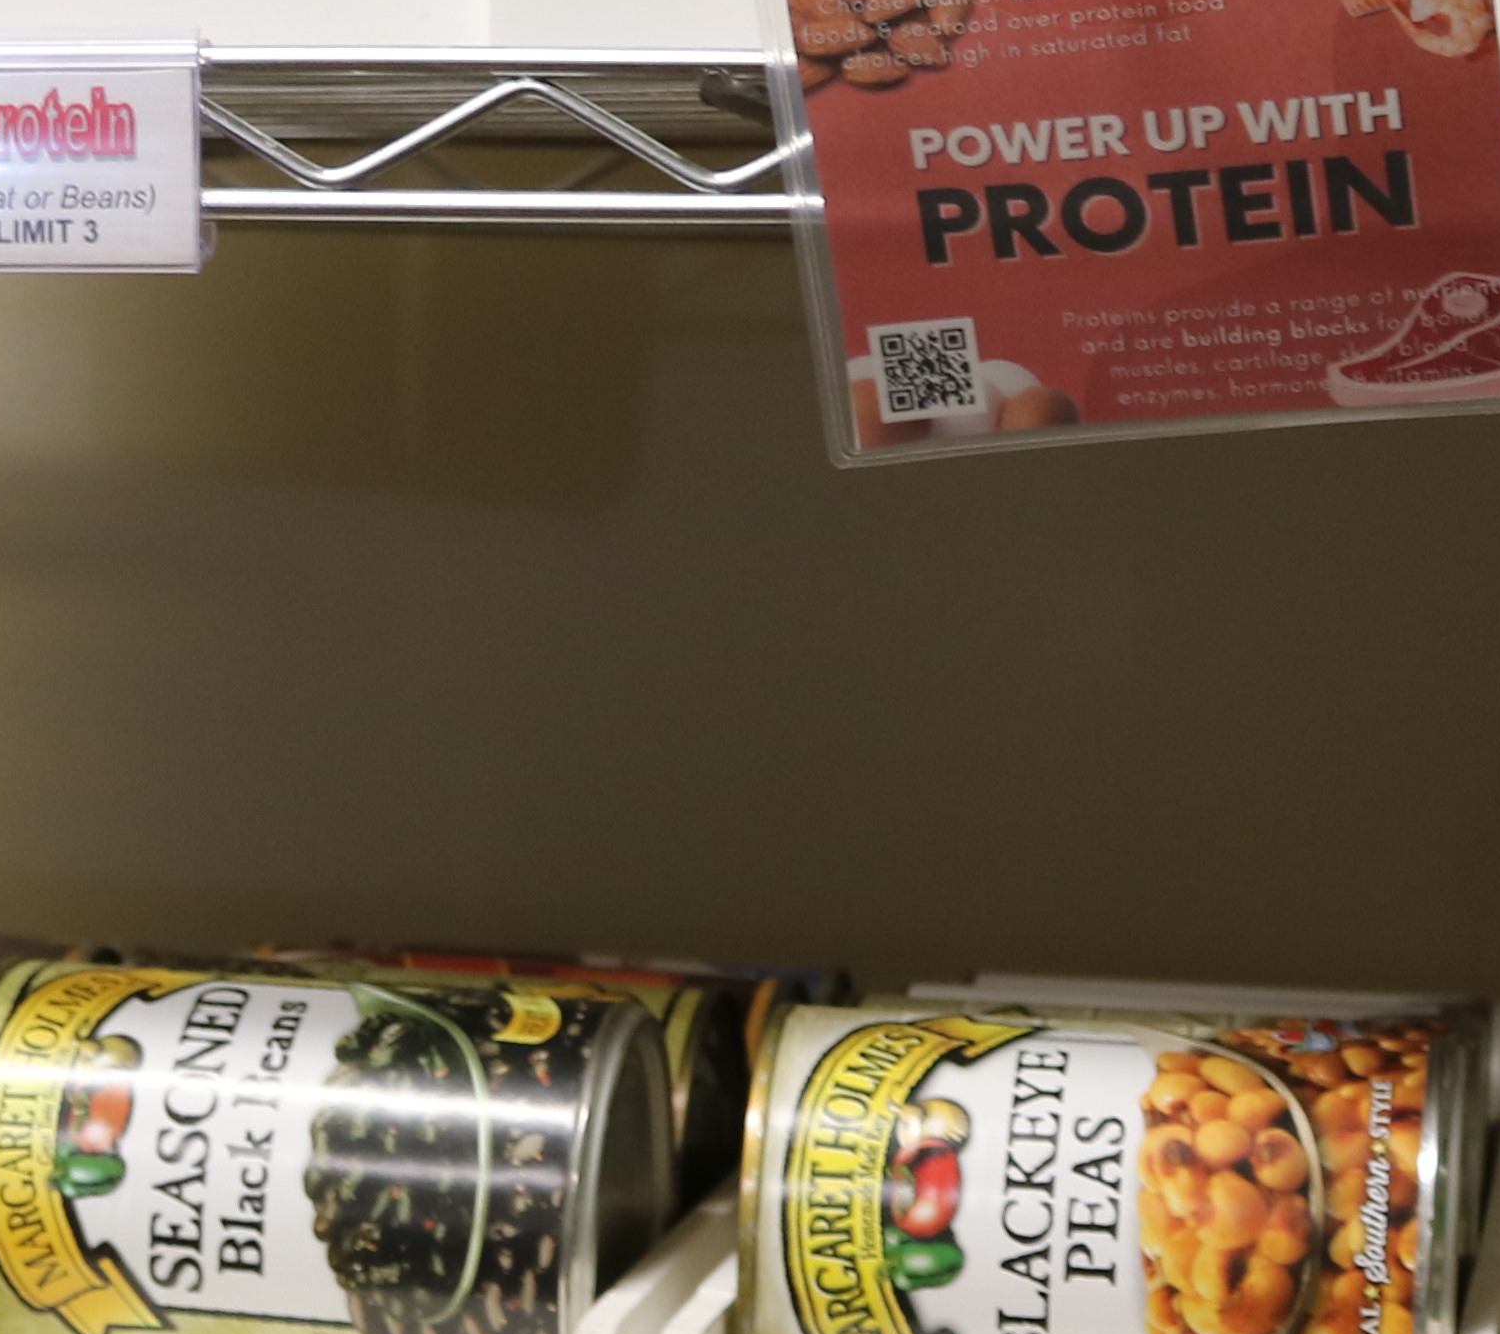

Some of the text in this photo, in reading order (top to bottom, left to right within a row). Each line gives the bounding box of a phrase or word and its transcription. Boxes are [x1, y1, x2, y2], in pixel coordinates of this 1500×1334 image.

[801, 22, 868, 45] foods
[900, 16, 999, 38] seafood
[1007, 12, 1060, 31] over
[1069, 2, 1157, 27] protein
[842, 24, 1193, 71] choices high saturated fat
[909, 89, 1403, 169] POWER UP WITH
[24, 190, 54, 209] or
[61, 183, 156, 214] Beans)
[83, 219, 99, 243] 3
[916, 151, 1417, 266] PROTEIN
[1061, 293, 1361, 329] Proteins provide range
[1081, 317, 1370, 354] and are building blocks
[824, 1027, 922, 1157] HOLMES
[1371, 1078, 1394, 1143] STYLE
[150, 987, 250, 1295] SEASONED
[219, 1131, 275, 1277] Black
[1063, 1115, 1127, 1286] PEAS
[1352, 1159, 1392, 1283] Southern
